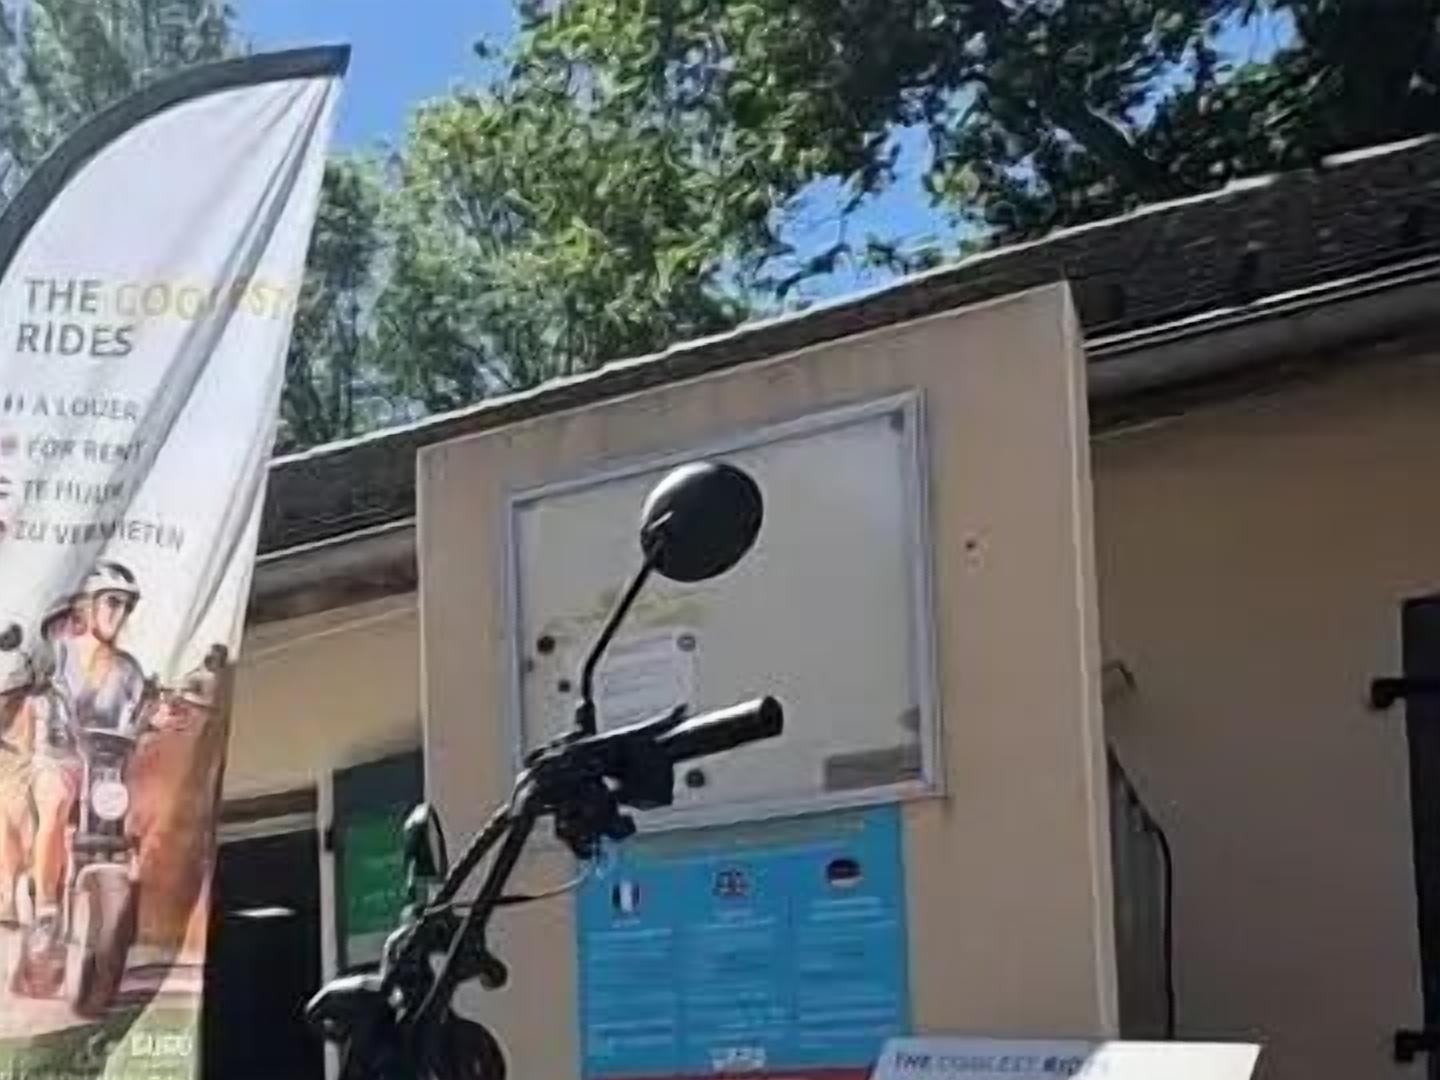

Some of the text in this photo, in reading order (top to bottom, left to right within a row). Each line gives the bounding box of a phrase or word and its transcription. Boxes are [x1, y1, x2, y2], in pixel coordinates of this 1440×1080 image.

[24, 278, 284, 320] THE COOST
[16, 322, 136, 357] RIDES
[27, 438, 75, 461] FOR
